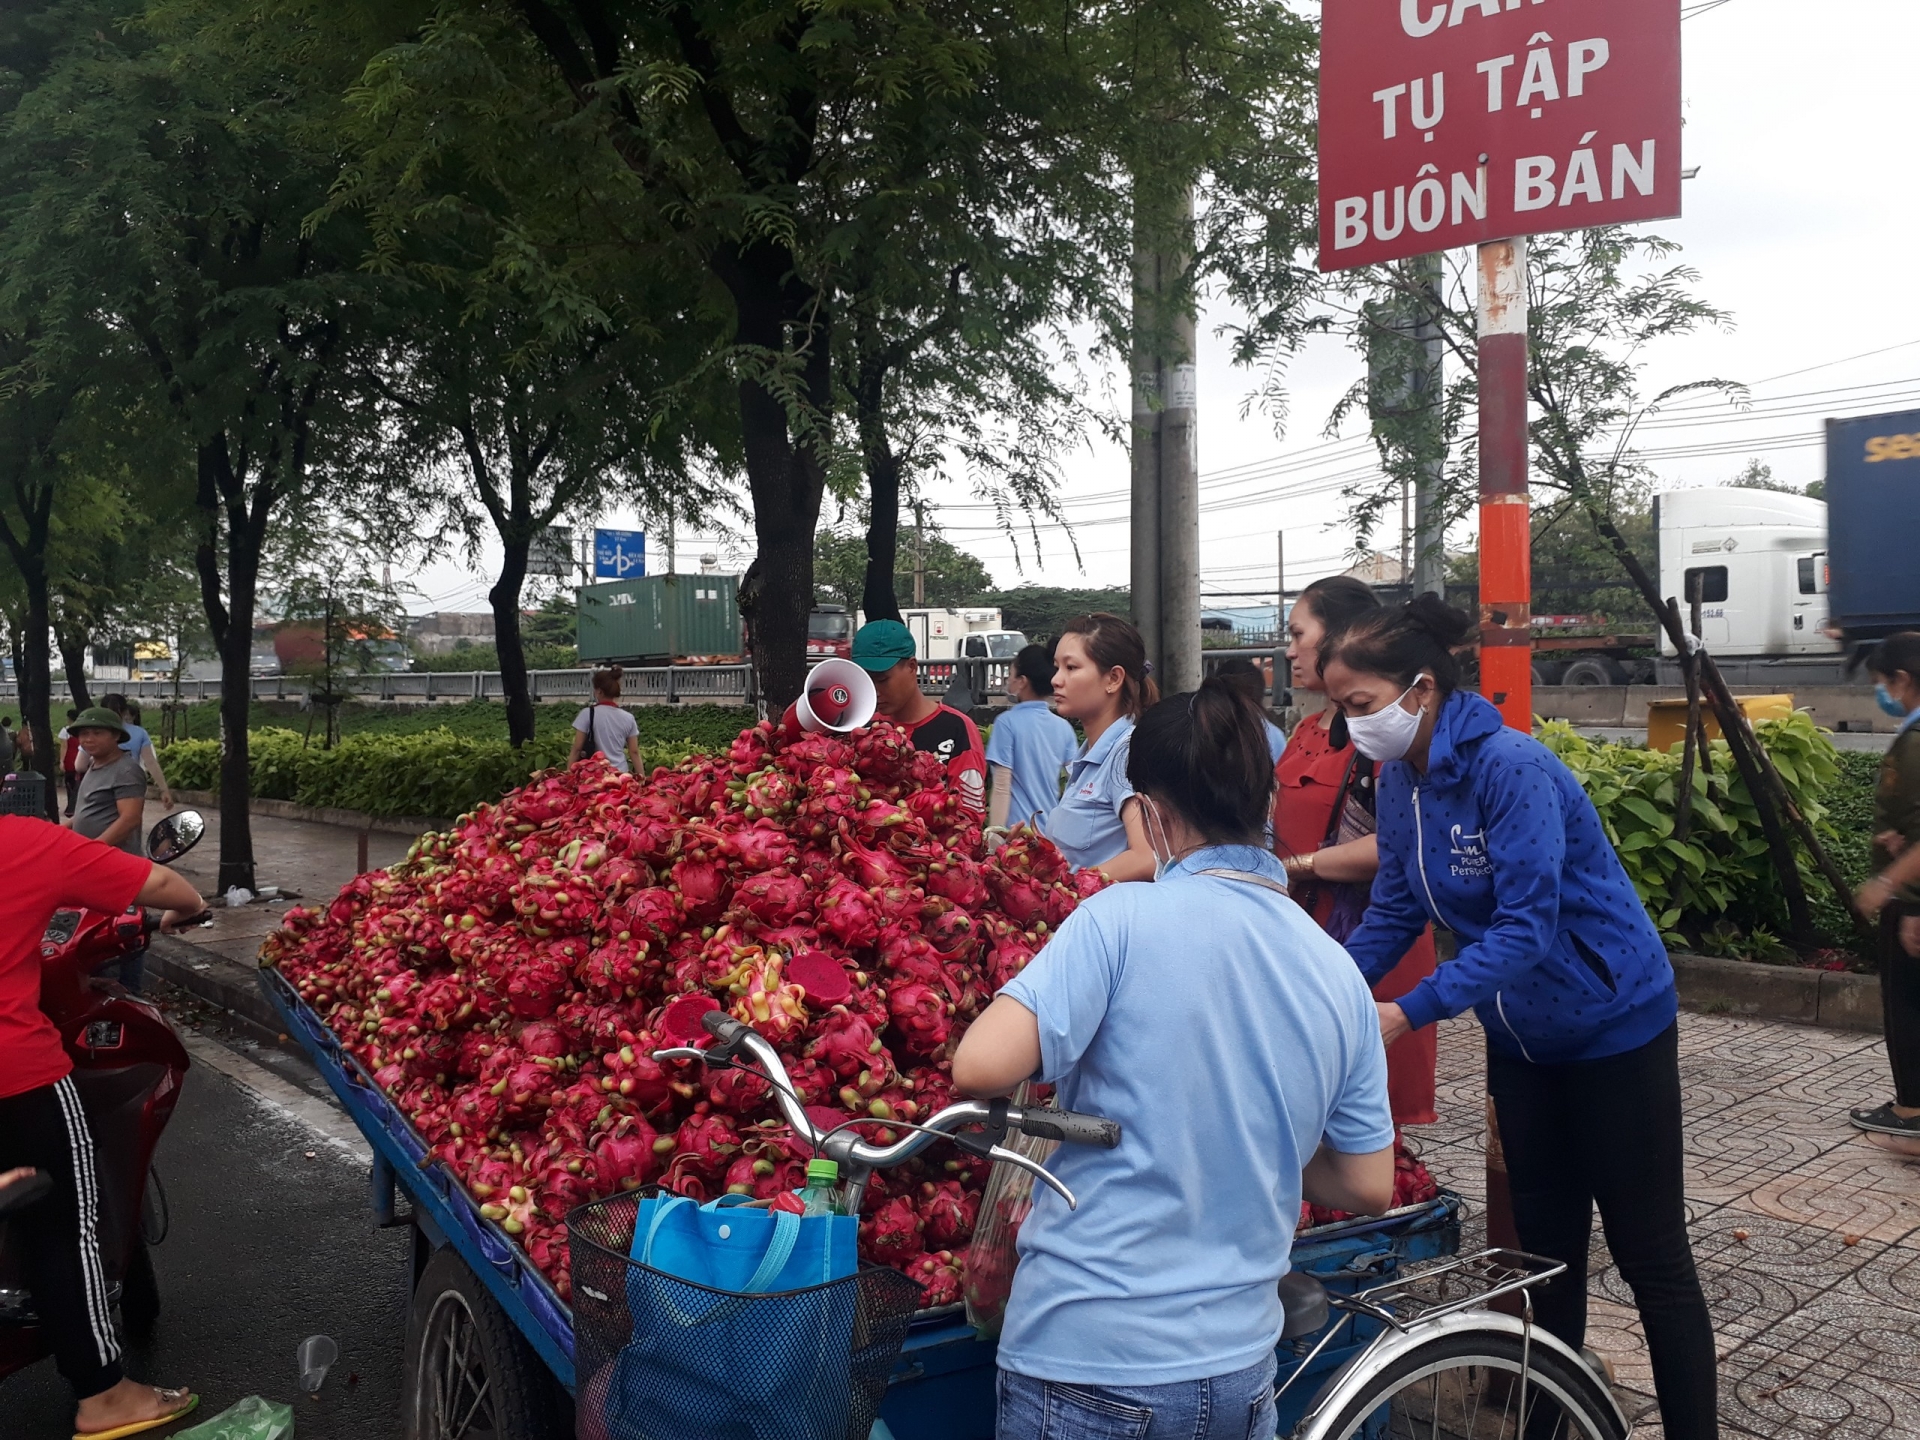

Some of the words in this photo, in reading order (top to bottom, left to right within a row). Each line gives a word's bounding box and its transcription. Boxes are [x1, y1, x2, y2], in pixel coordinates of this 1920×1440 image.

[1372, 71, 1444, 143] TỤ
[1476, 31, 1610, 120] TẬP
[1334, 162, 1488, 251] BUÔN
[1513, 130, 1656, 213] BÁN
